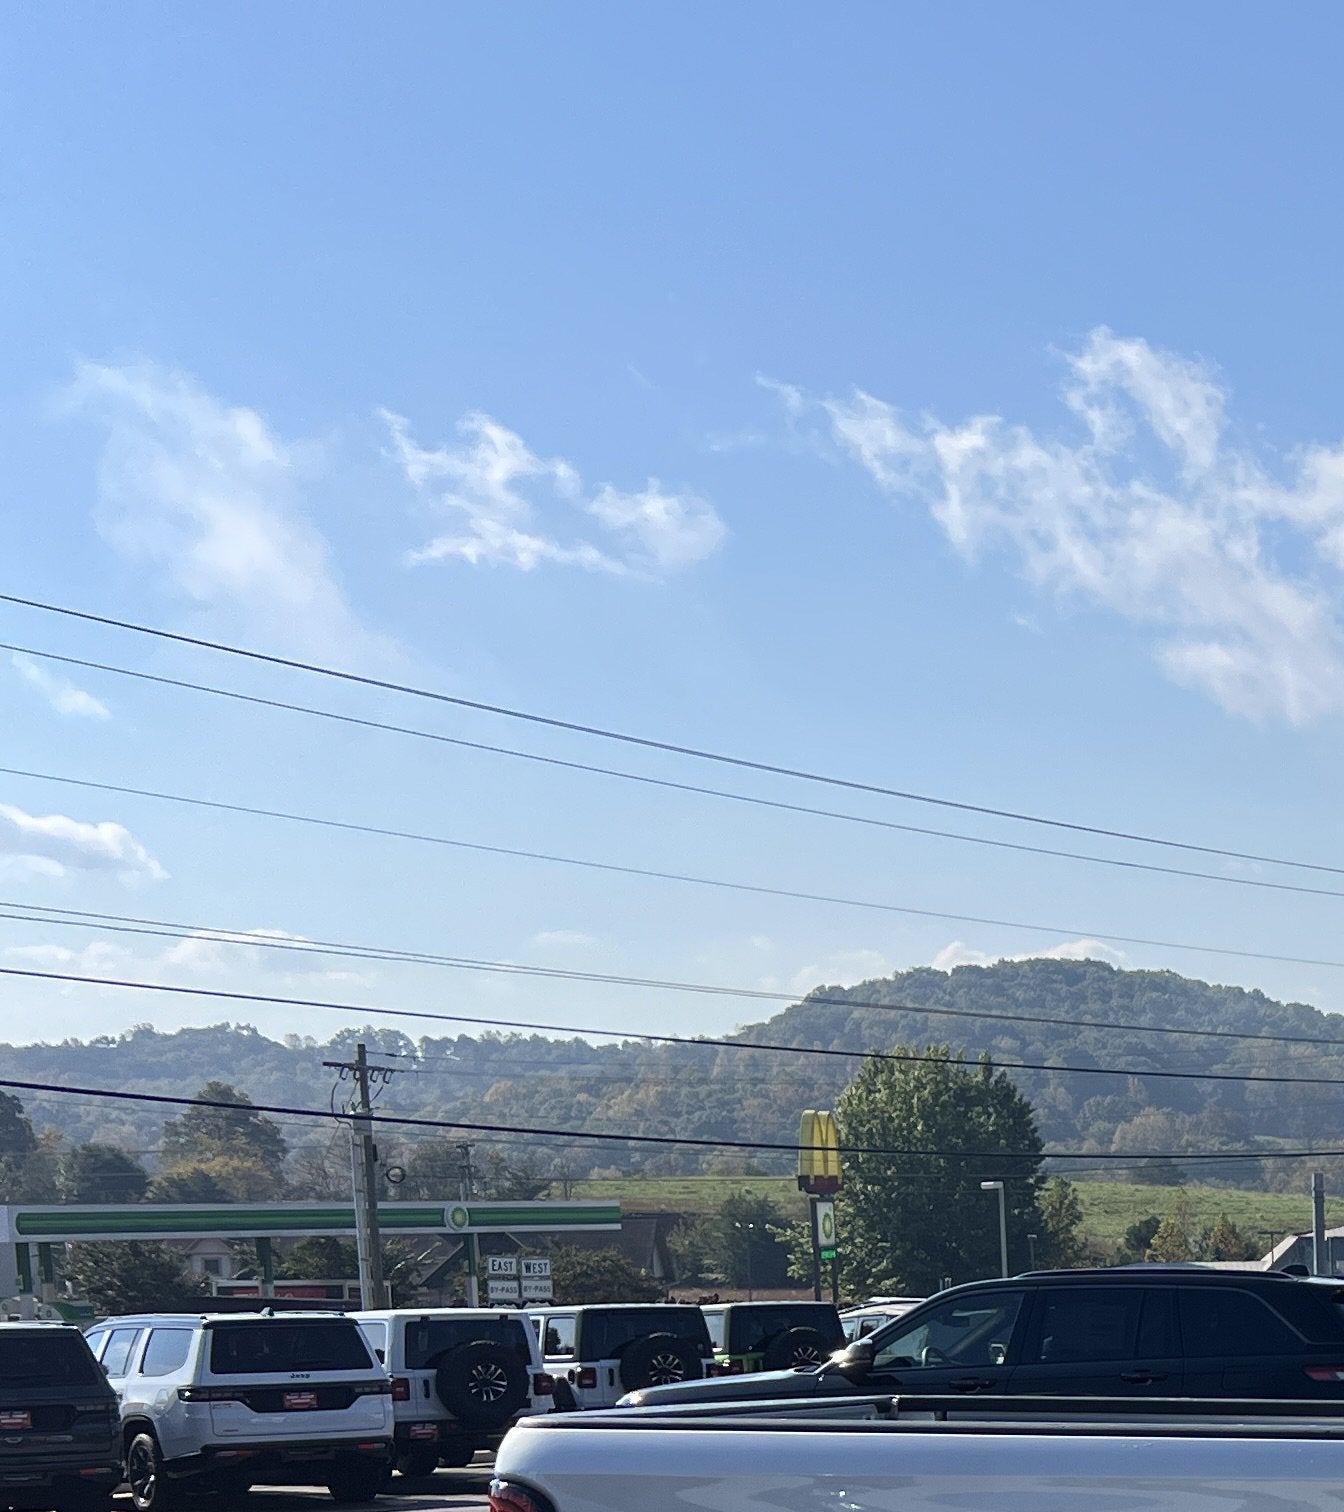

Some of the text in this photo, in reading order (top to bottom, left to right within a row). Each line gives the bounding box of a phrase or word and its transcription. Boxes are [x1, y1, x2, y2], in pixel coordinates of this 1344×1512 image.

[491, 1259, 514, 1272] EAST
[524, 1261, 548, 1274] WEST
[490, 1286, 518, 1294] BY-PASS
[523, 1285, 551, 1293] BY-PASS
